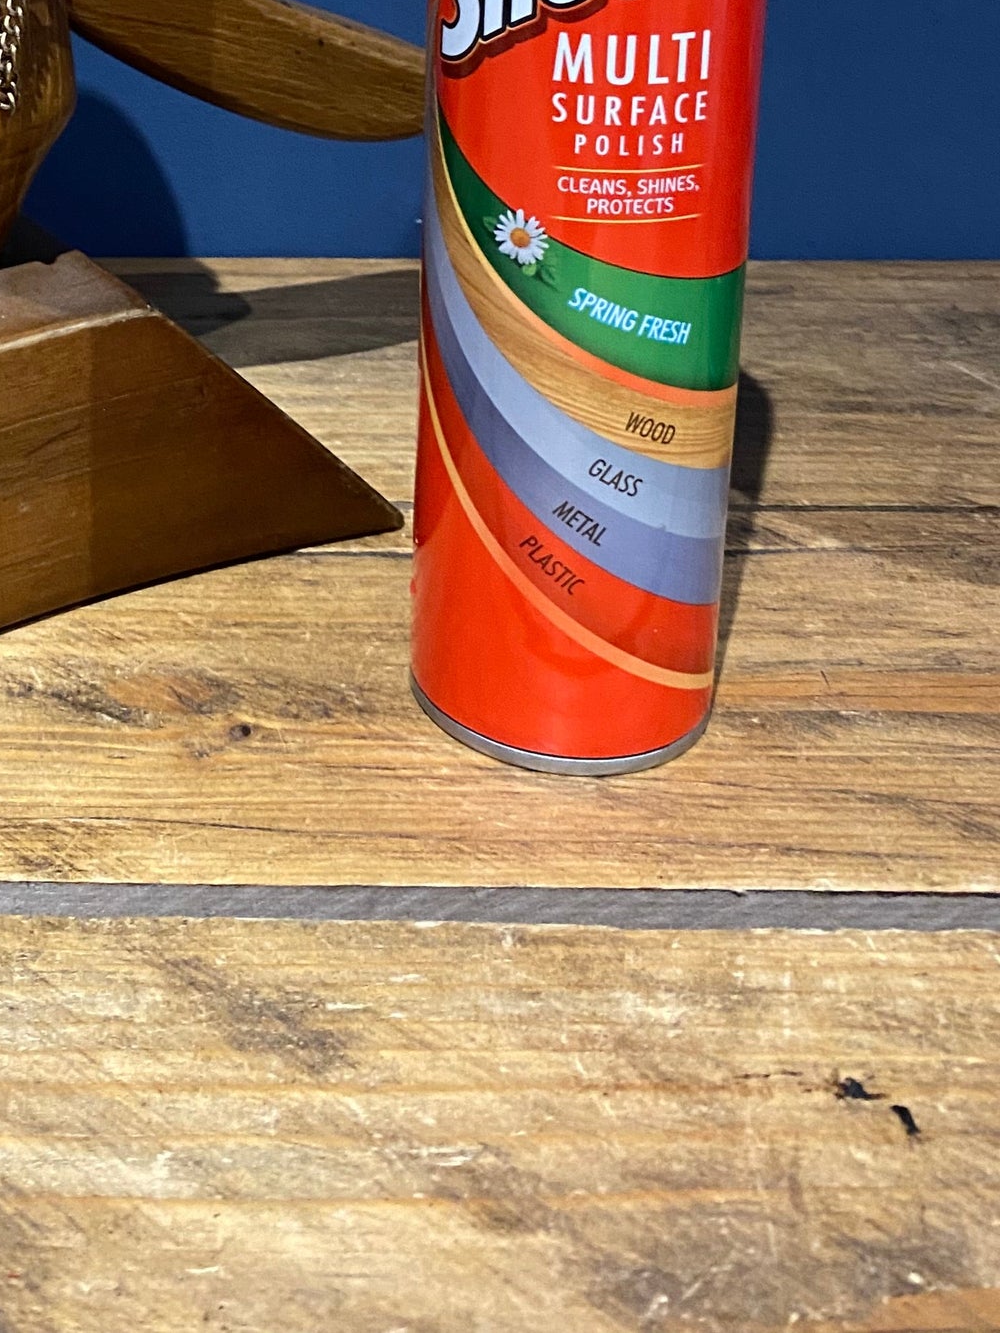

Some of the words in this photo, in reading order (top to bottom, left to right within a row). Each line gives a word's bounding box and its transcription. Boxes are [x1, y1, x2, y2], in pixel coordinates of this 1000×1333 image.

[552, 29, 711, 86] MULTI
[551, 90, 709, 126] SURFACE
[574, 132, 684, 156] POLISH
[557, 176, 632, 197] CLEANS,
[636, 174, 700, 195] SHINES,
[586, 196, 674, 215] PROTECTS
[568, 287, 640, 331] SPRING
[637, 315, 692, 345] FRESH
[625, 412, 677, 445] WOOD
[589, 458, 644, 497] GLASS
[552, 501, 607, 547] METAL
[519, 535, 586, 596] PLASTIC
